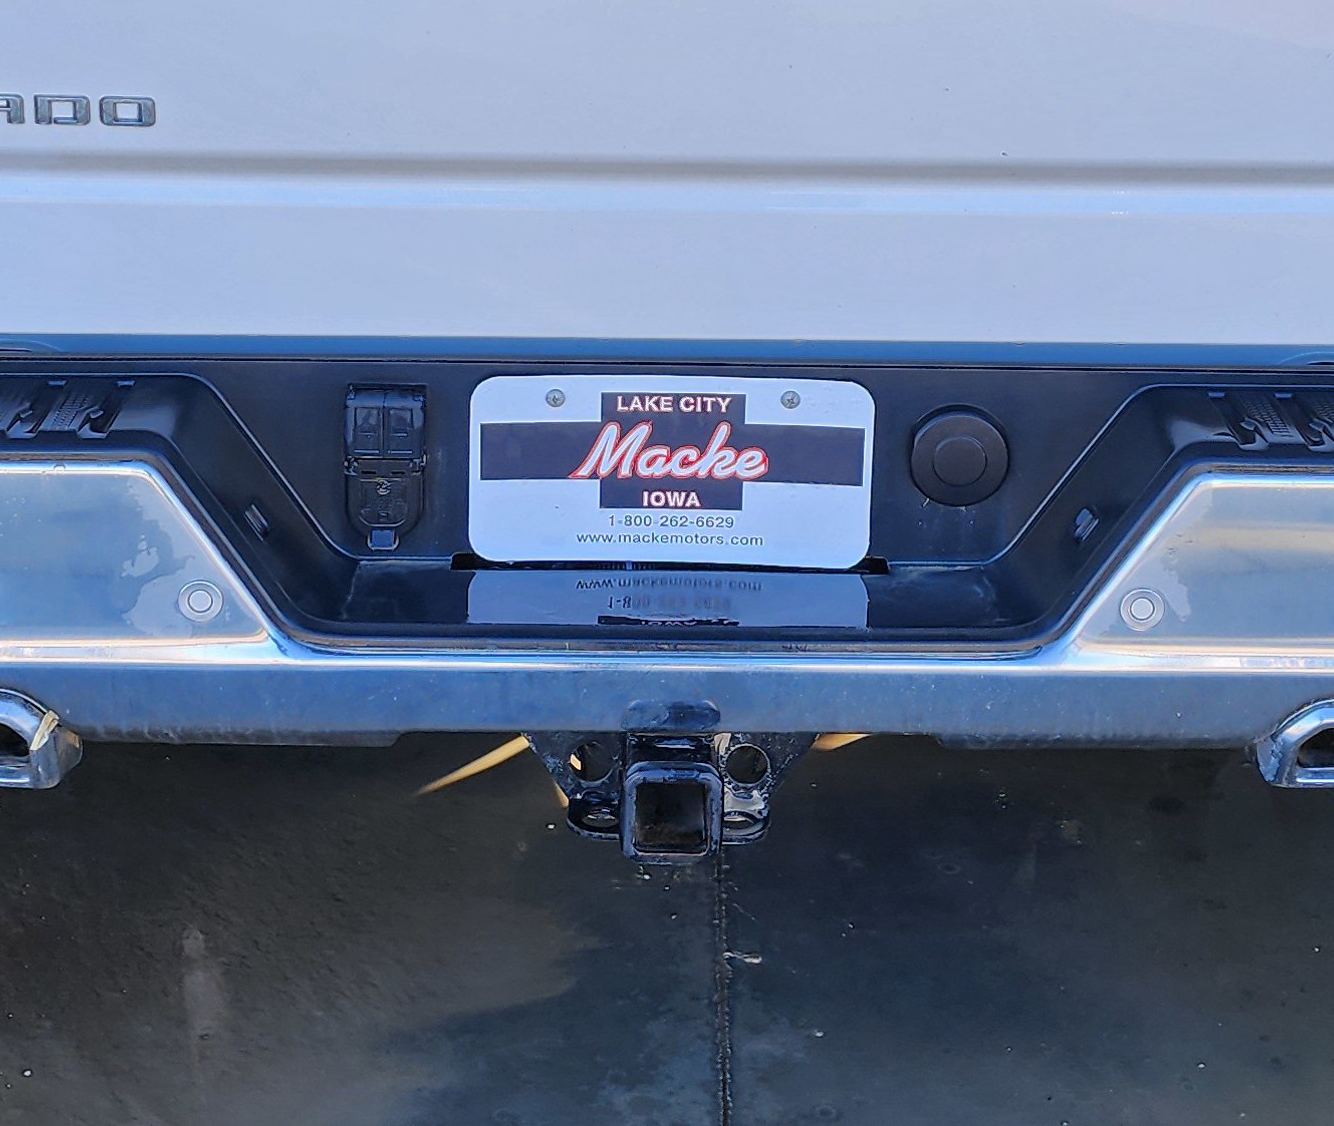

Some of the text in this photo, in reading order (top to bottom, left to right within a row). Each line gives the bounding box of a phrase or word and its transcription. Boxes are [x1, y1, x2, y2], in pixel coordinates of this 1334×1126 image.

[616, 395, 733, 414] LAKE CITY
[568, 420, 769, 481] Macke
[642, 490, 702, 508] IOWA
[608, 514, 735, 529] 1-800-262-6629
[576, 531, 764, 546] www.mackemotors.com
